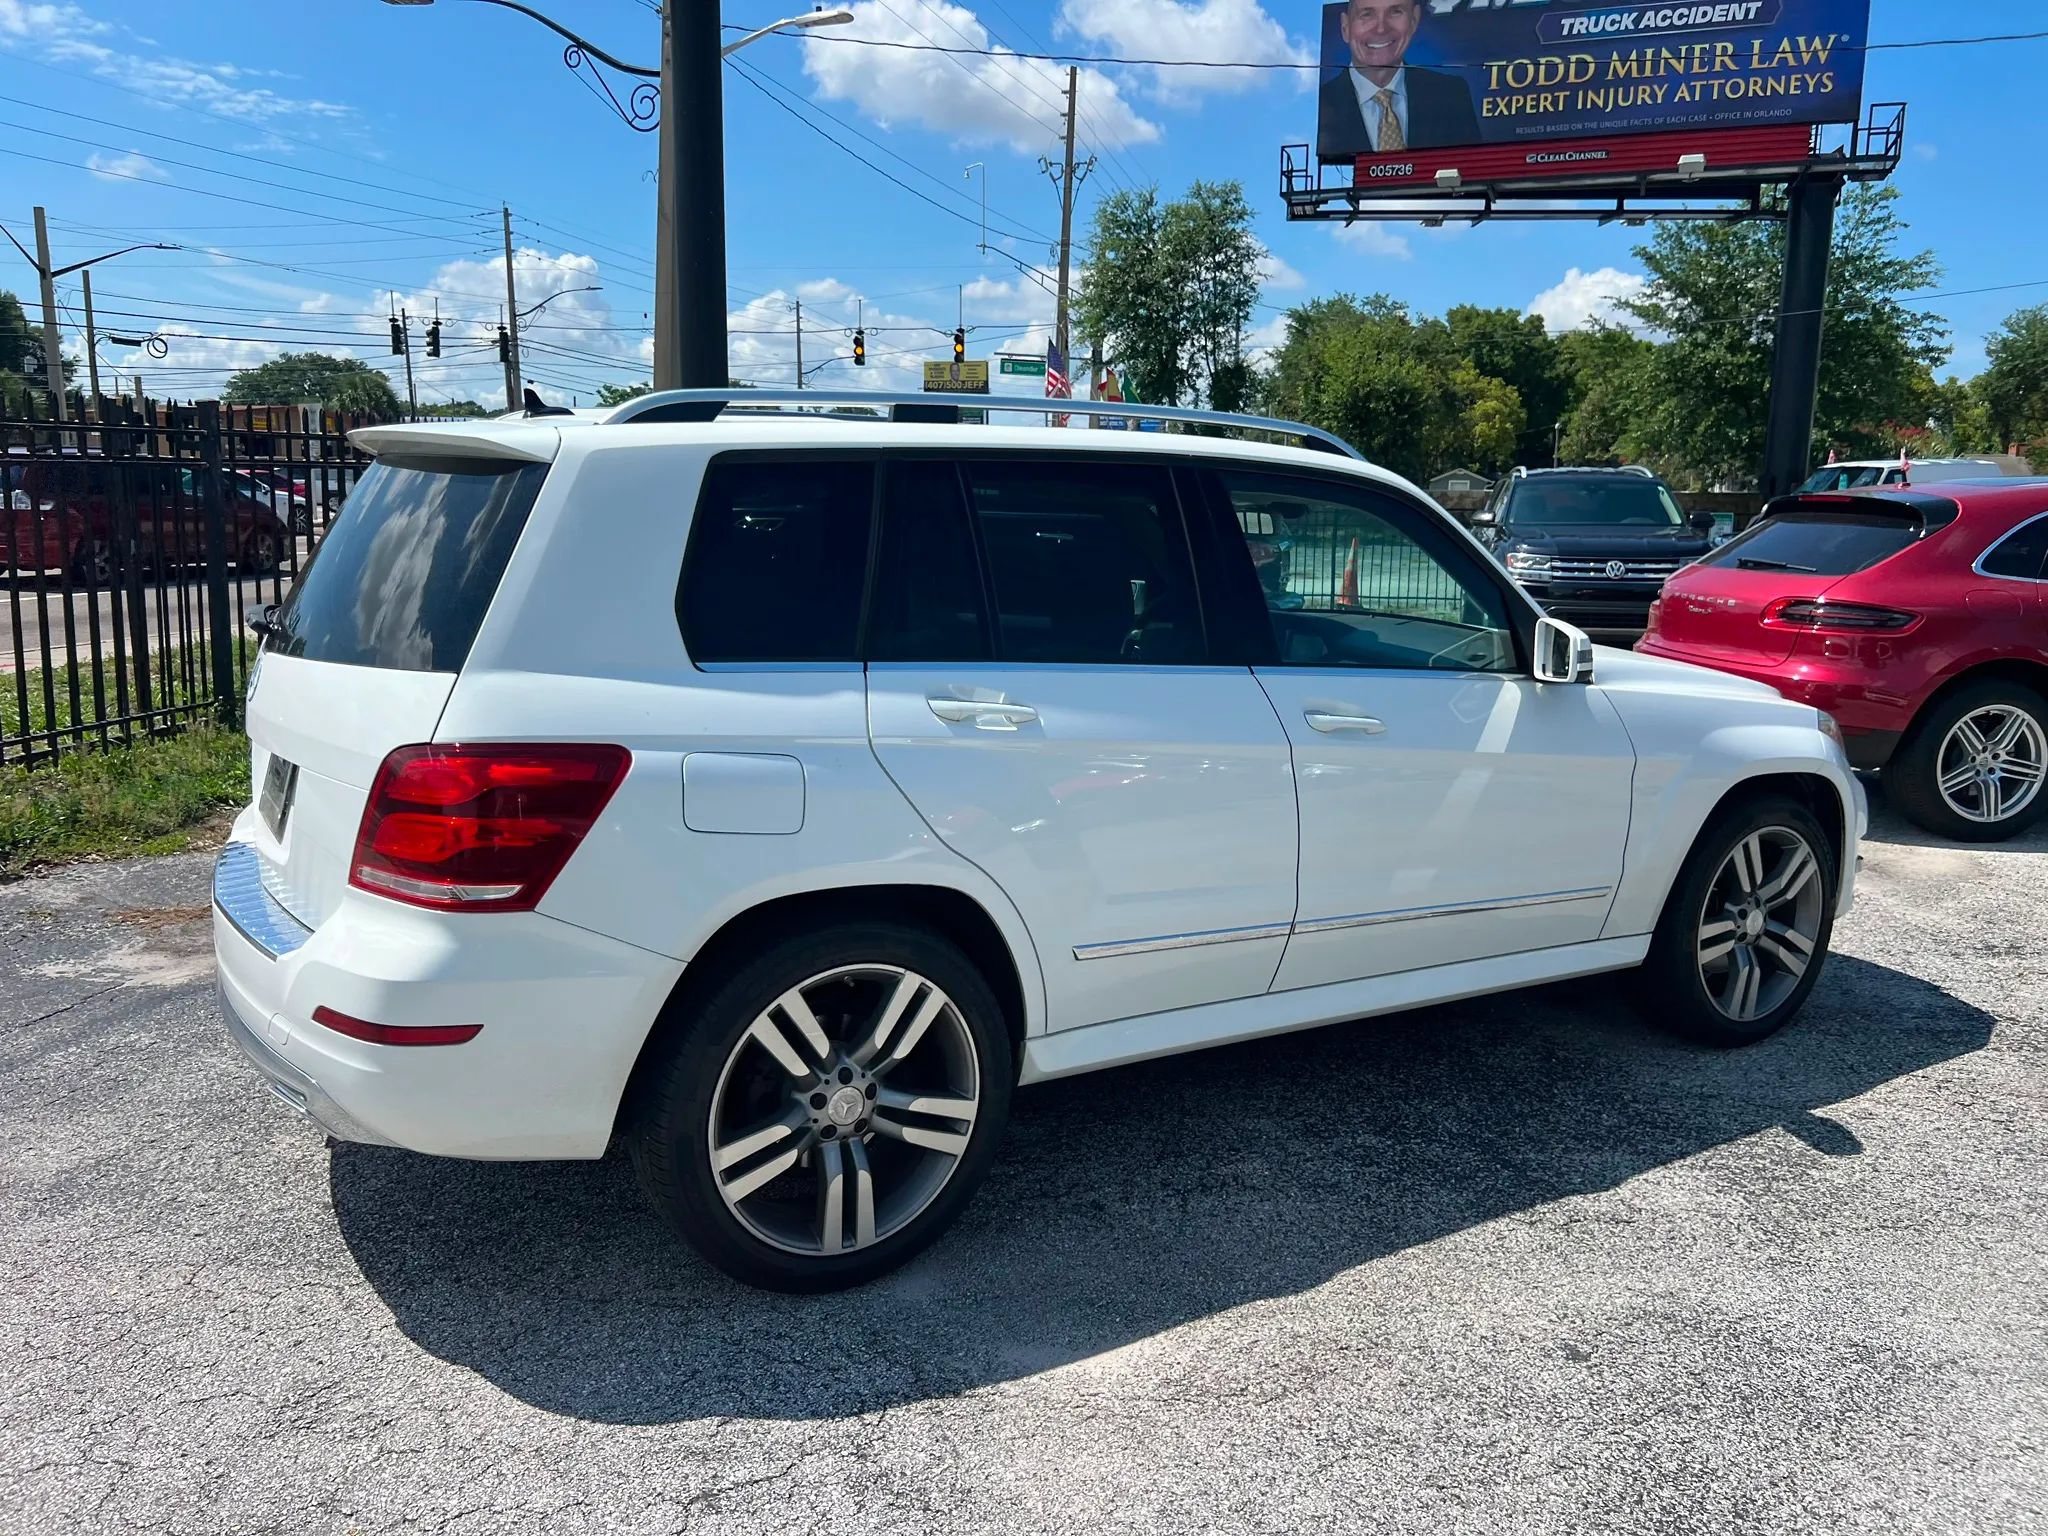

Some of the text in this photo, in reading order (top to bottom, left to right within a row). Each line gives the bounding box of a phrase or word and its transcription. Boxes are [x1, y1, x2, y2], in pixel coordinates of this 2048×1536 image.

[1560, 1, 1763, 36] TRUCK ACCIDENT
[1482, 53, 1597, 90] TODD
[1605, 42, 1740, 81] MINER
[1482, 72, 1834, 117] EXPERT INJURY ATTORNEYS
[1515, 108, 1792, 135] RESULTS BASED ON THE UNIQUE FACTS OF EACH CASE OFFICE IN ORLANDO
[1369, 163, 1413, 177] 005736
